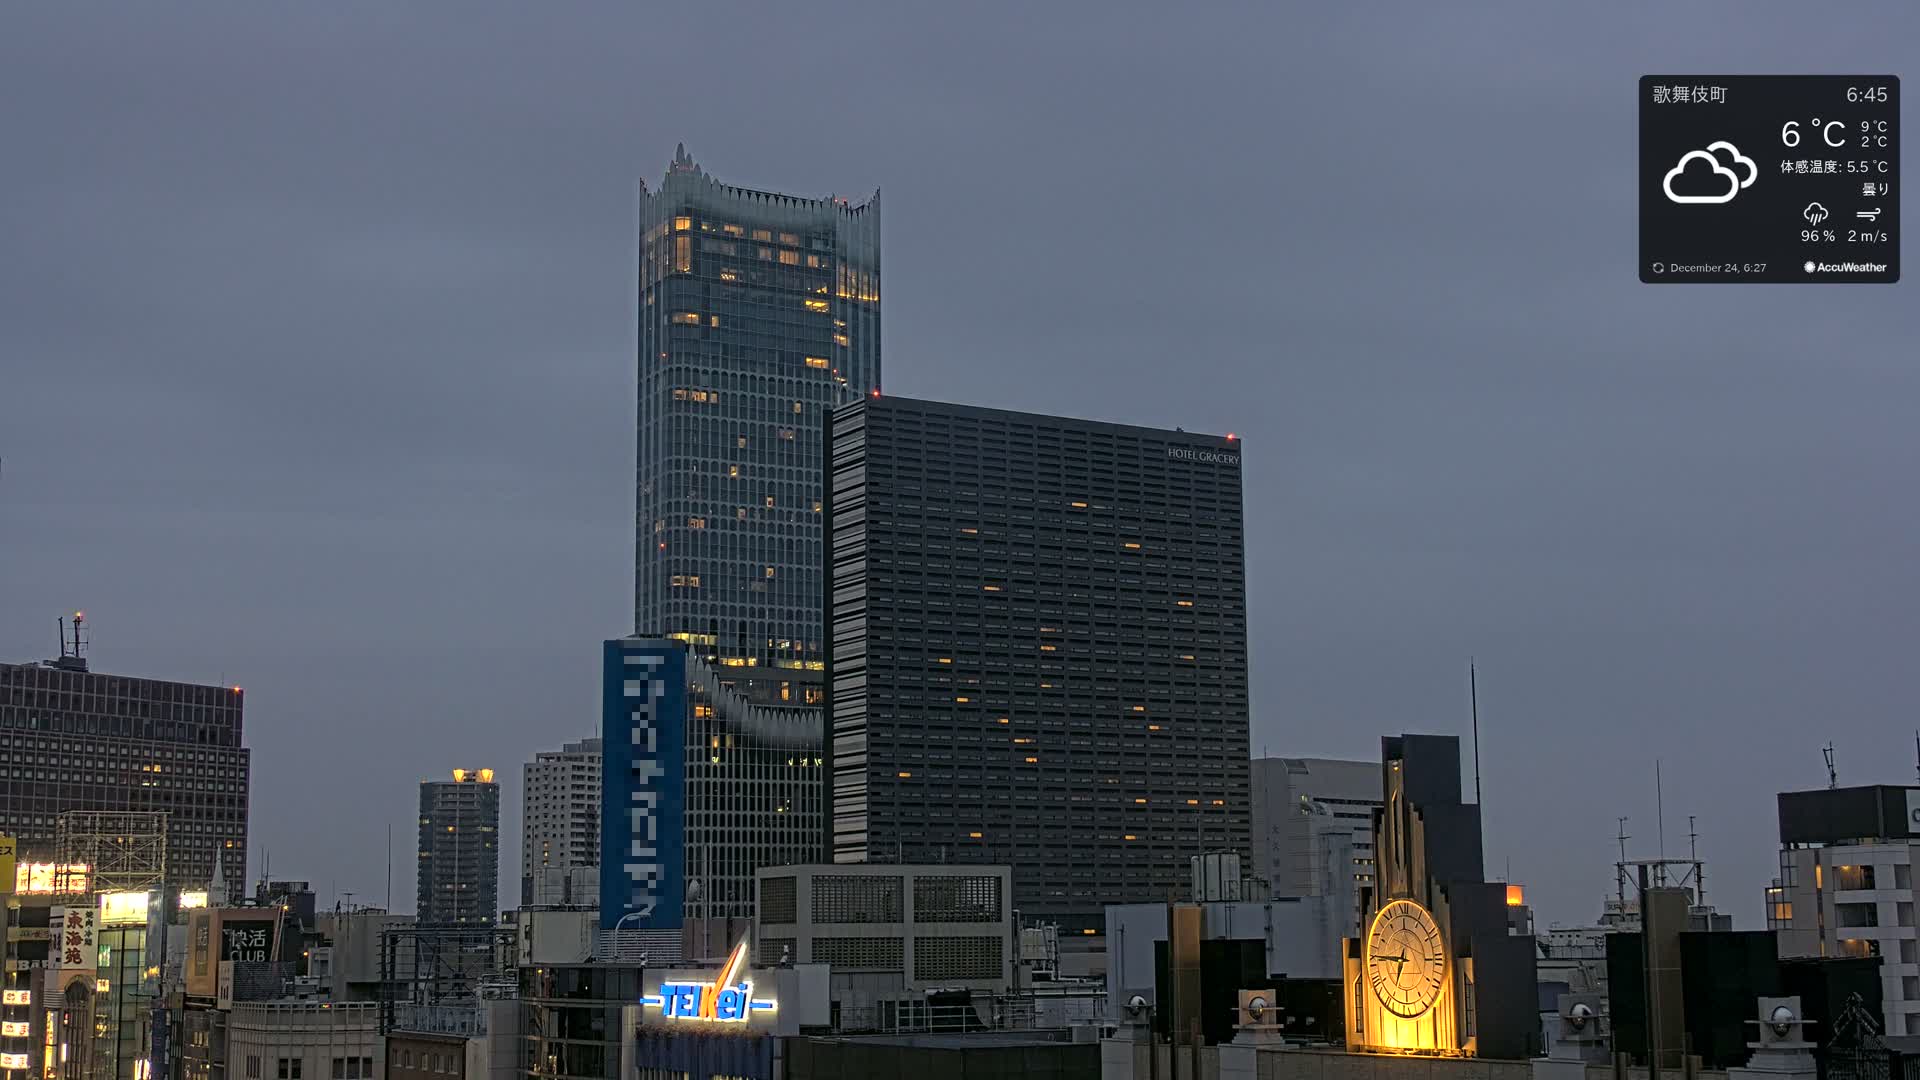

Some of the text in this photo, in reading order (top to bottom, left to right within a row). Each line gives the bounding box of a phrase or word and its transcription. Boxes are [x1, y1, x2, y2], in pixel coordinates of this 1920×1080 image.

[1168, 447, 1240, 464] HOTEL GRACERY
[64, 910, 83, 965] 東海苑
[229, 928, 266, 948] 快活
[230, 950, 266, 962] CLUB
